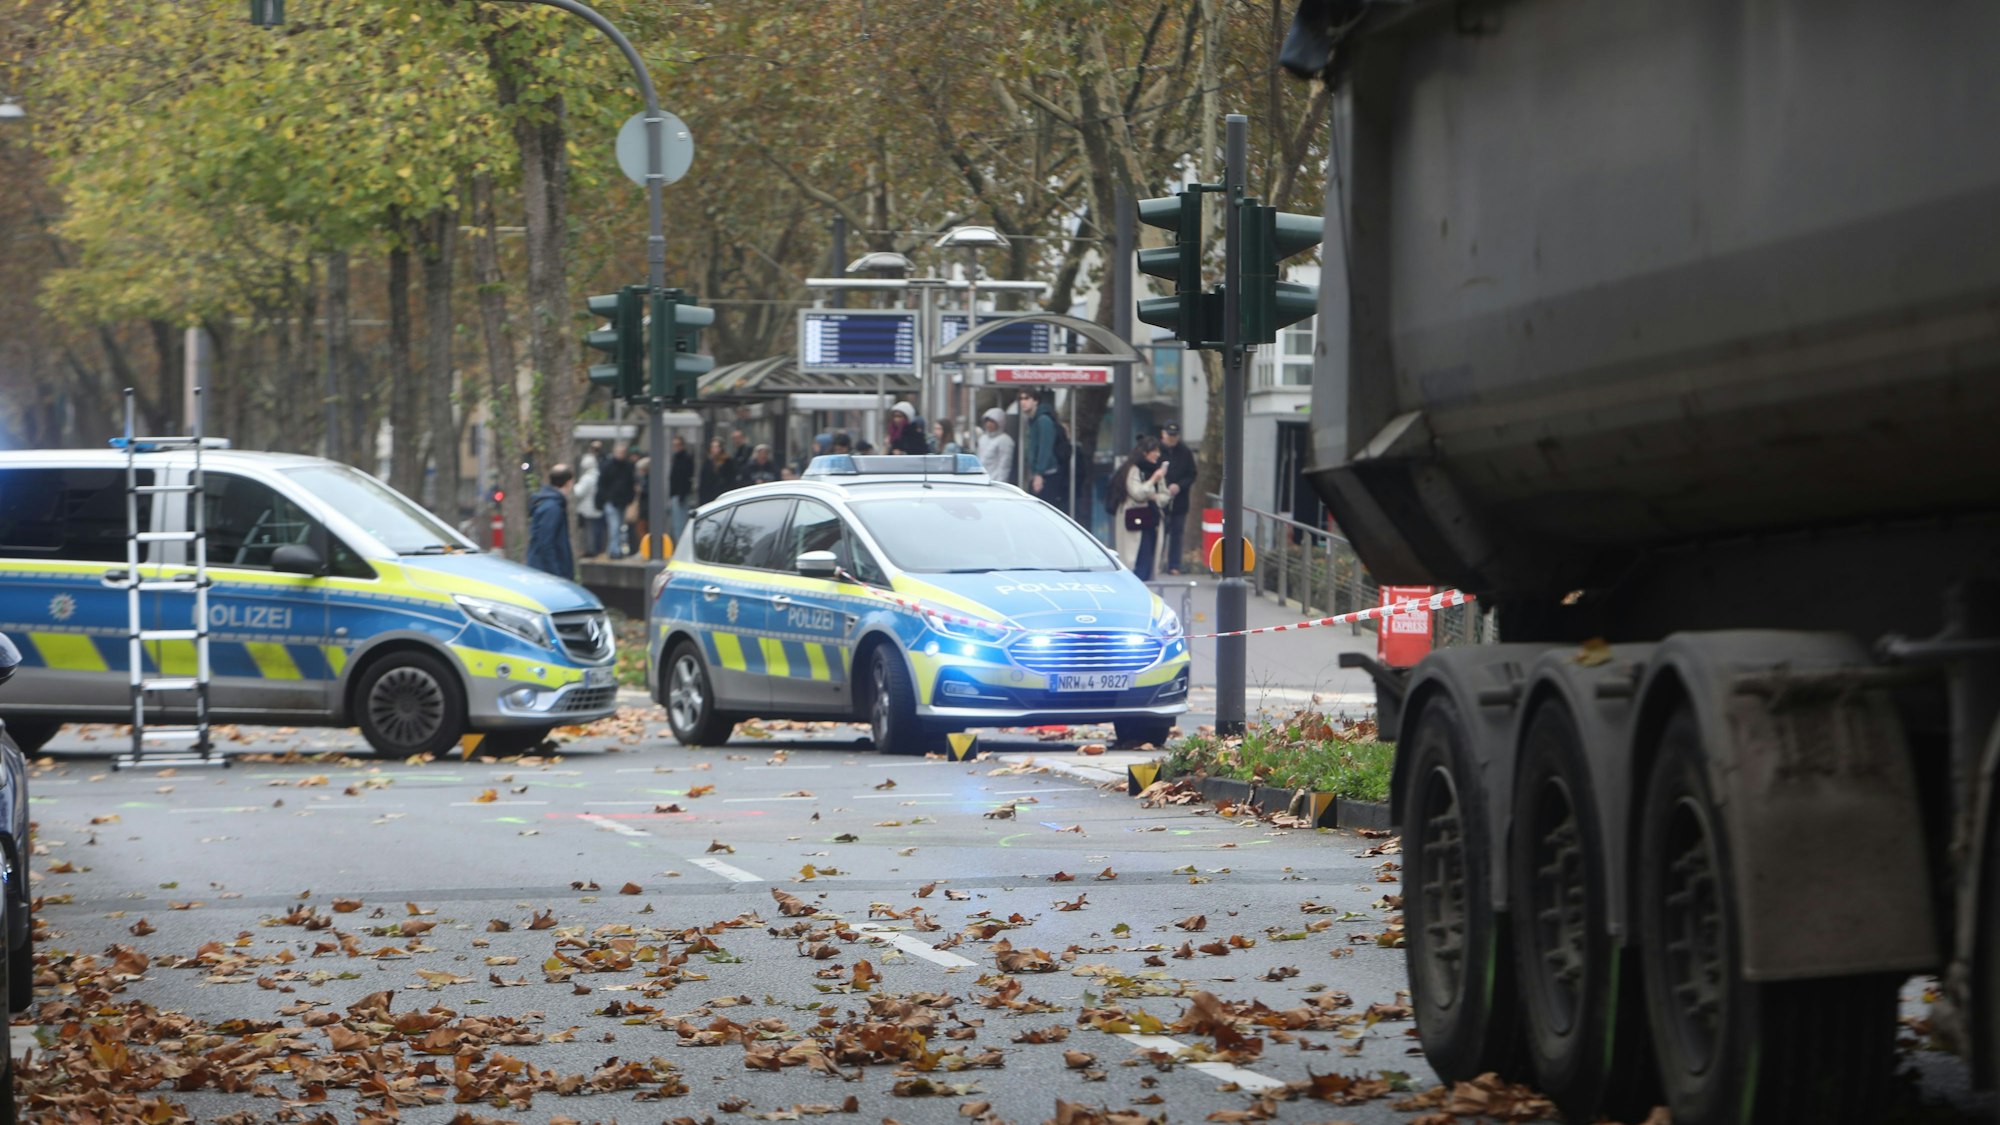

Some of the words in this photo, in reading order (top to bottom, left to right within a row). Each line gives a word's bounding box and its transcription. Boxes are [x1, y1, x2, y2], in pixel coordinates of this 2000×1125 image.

[995, 582, 1117, 595] POLIZEI
[787, 606, 834, 631] POLIZEI
[1058, 675, 1080, 689] NRW
[1087, 674, 1128, 689] 4-9827
